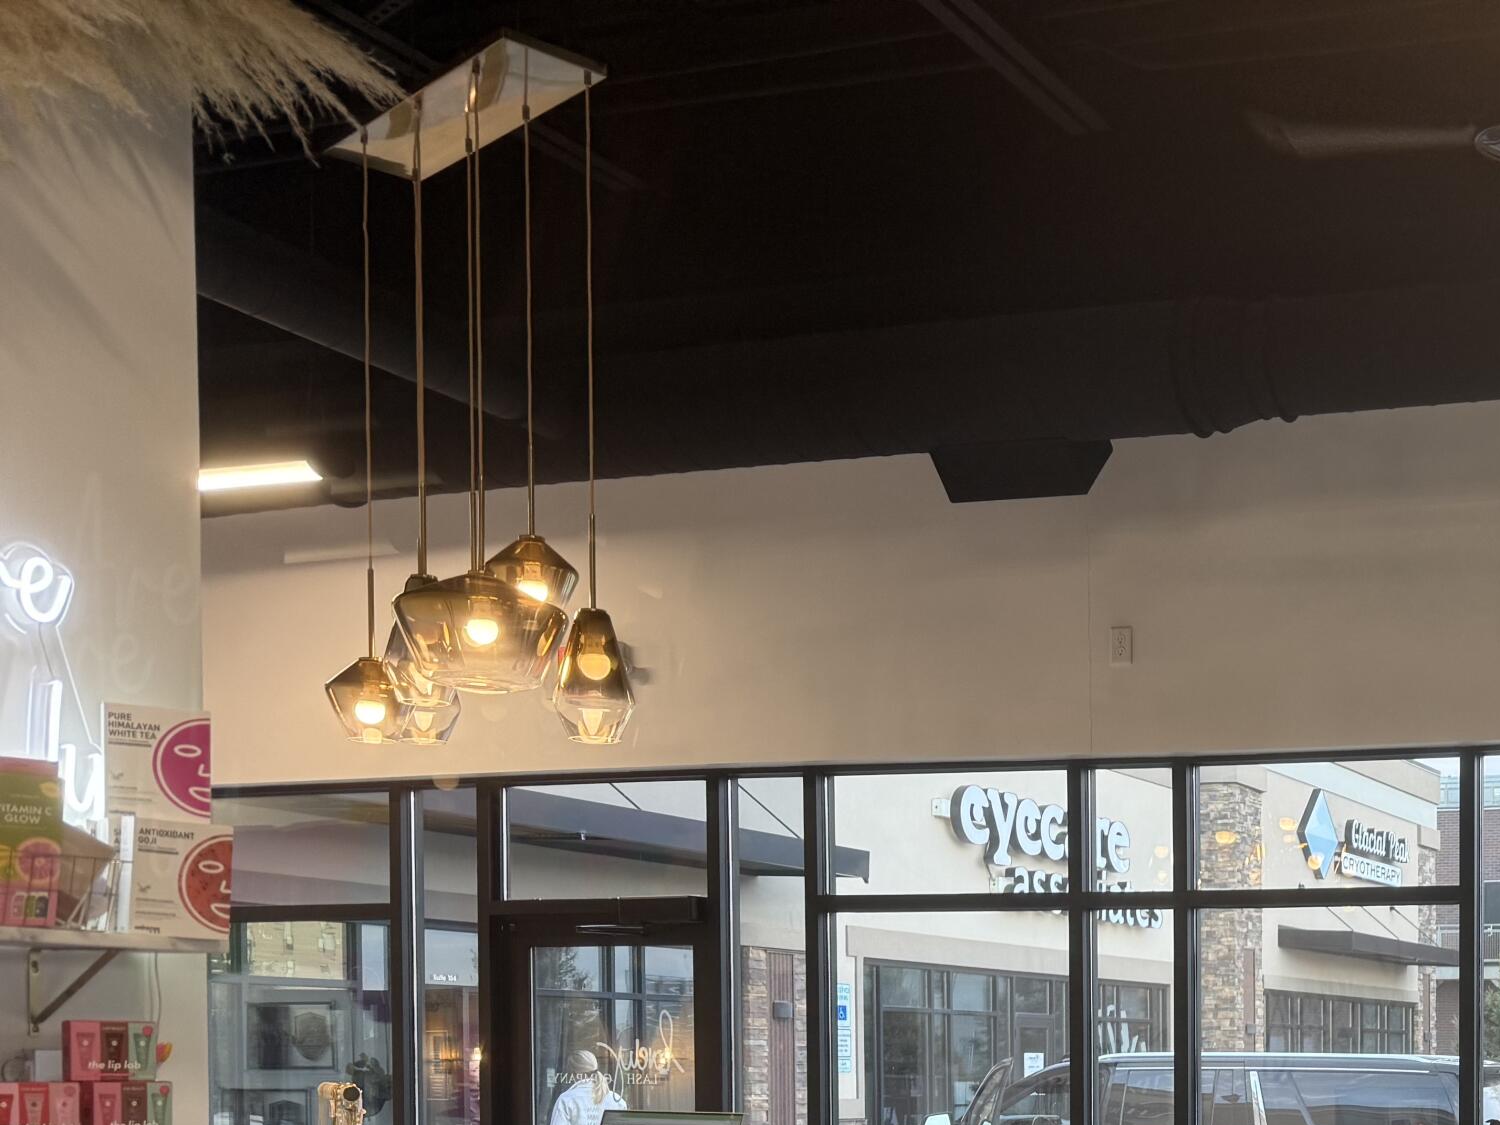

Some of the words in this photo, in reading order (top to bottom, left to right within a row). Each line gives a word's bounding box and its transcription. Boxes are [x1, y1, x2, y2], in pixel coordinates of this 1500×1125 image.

[107, 711, 132, 721] PURE
[107, 720, 160, 732] HIMALAYAN
[108, 729, 139, 739] WHITE
[140, 731, 157, 740] TEA
[0, 802, 42, 816] ITAMIN
[44, 806, 52, 817] C
[4, 812, 41, 825] GLOW
[139, 827, 195, 840] ANTIOXIDANT
[951, 784, 1130, 874] eyecre
[138, 836, 157, 845] GOJI
[1350, 819, 1387, 858] Glacial
[1388, 831, 1410, 864] Peak
[1343, 855, 1401, 882] CRYOTHERAPY
[87, 1060, 106, 1070] the
[107, 1060, 122, 1072] lip
